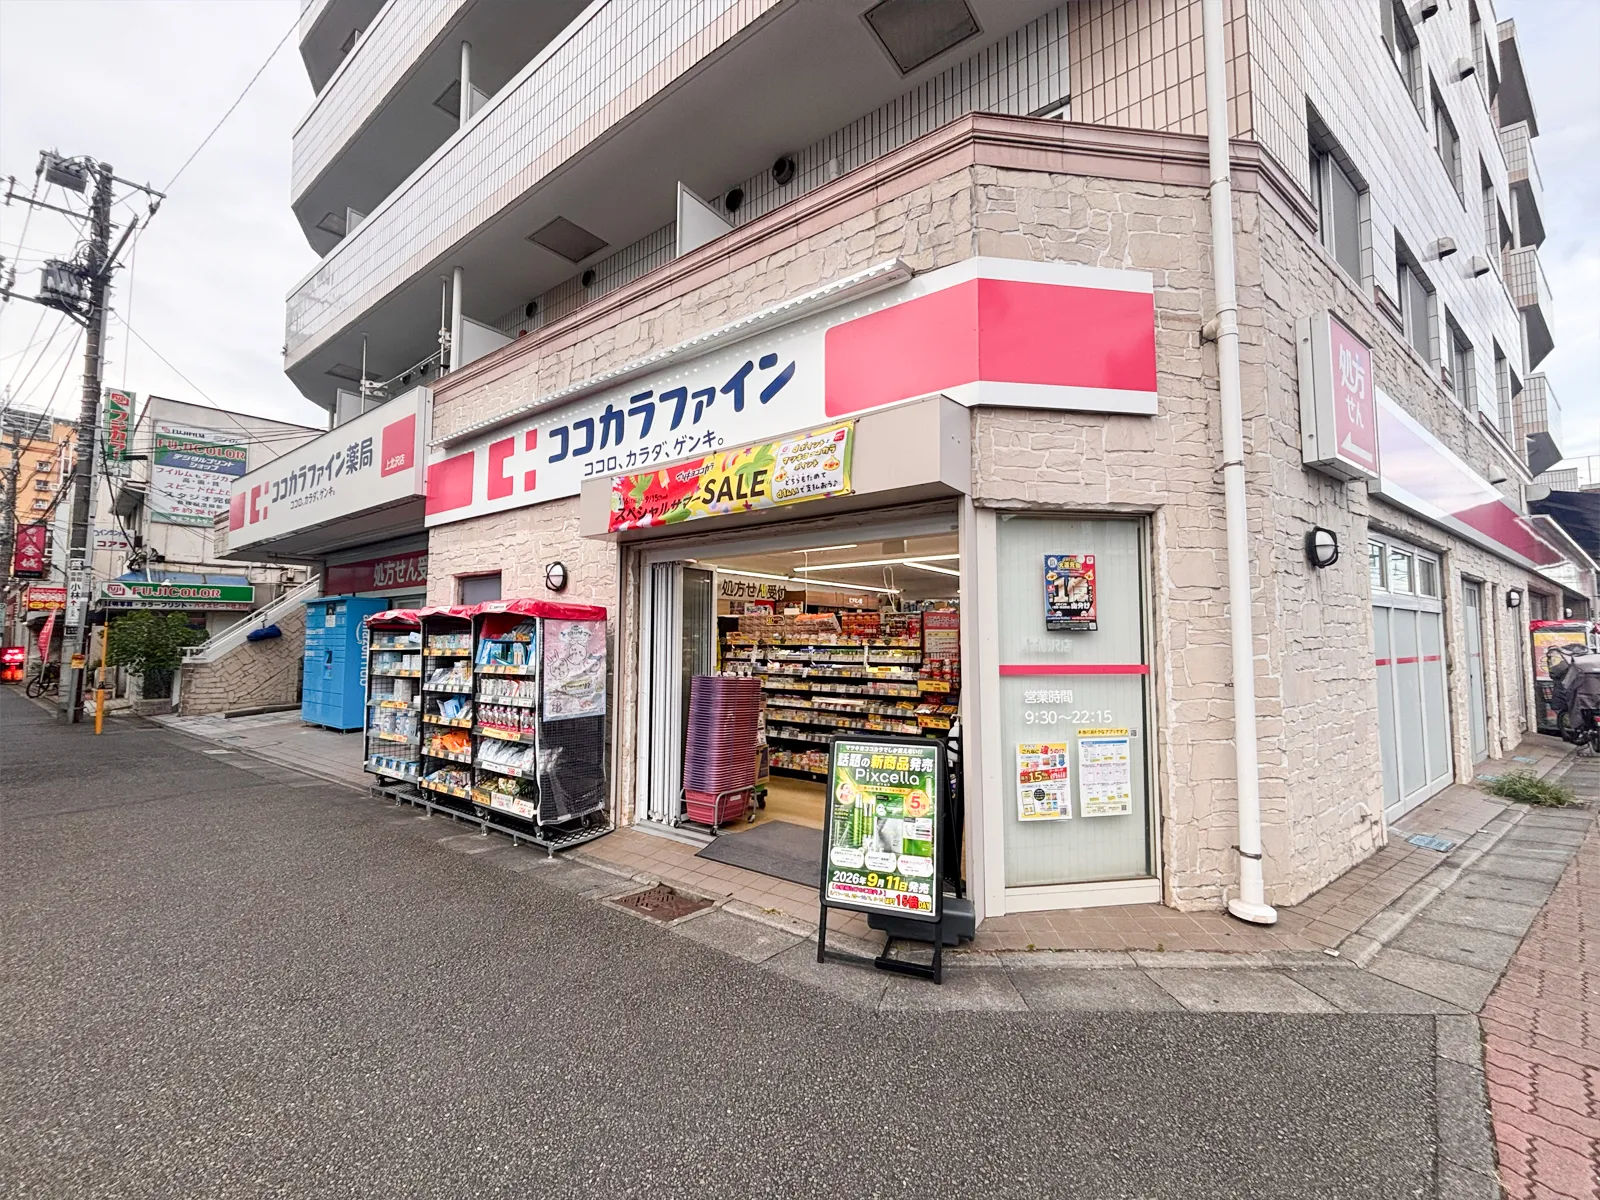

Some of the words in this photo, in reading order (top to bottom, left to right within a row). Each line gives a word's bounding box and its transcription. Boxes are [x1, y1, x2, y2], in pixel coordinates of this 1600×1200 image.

[1339, 343, 1366, 400] 処方
[548, 352, 796, 464] ココカラファイン
[1345, 394, 1365, 429] せん
[157, 438, 245, 460] FUJICOLOR
[583, 434, 724, 477] ココロ、カラダ、ゲンキ。
[173, 453, 235, 467] デジタルプリント
[271, 436, 373, 504] ココカラファイン薬局
[385, 454, 405, 471] 上北沢店
[702, 469, 768, 506] SALE
[96, 540, 128, 549] コアラ
[373, 555, 428, 587] 処方せん受
[70, 582, 81, 600] 小林
[131, 587, 221, 599] FUJICOLOR
[1024, 689, 1073, 704] 営業時間
[837, 752, 934, 773] 話題の新商品発売
[855, 768, 920, 786] Pixcella
